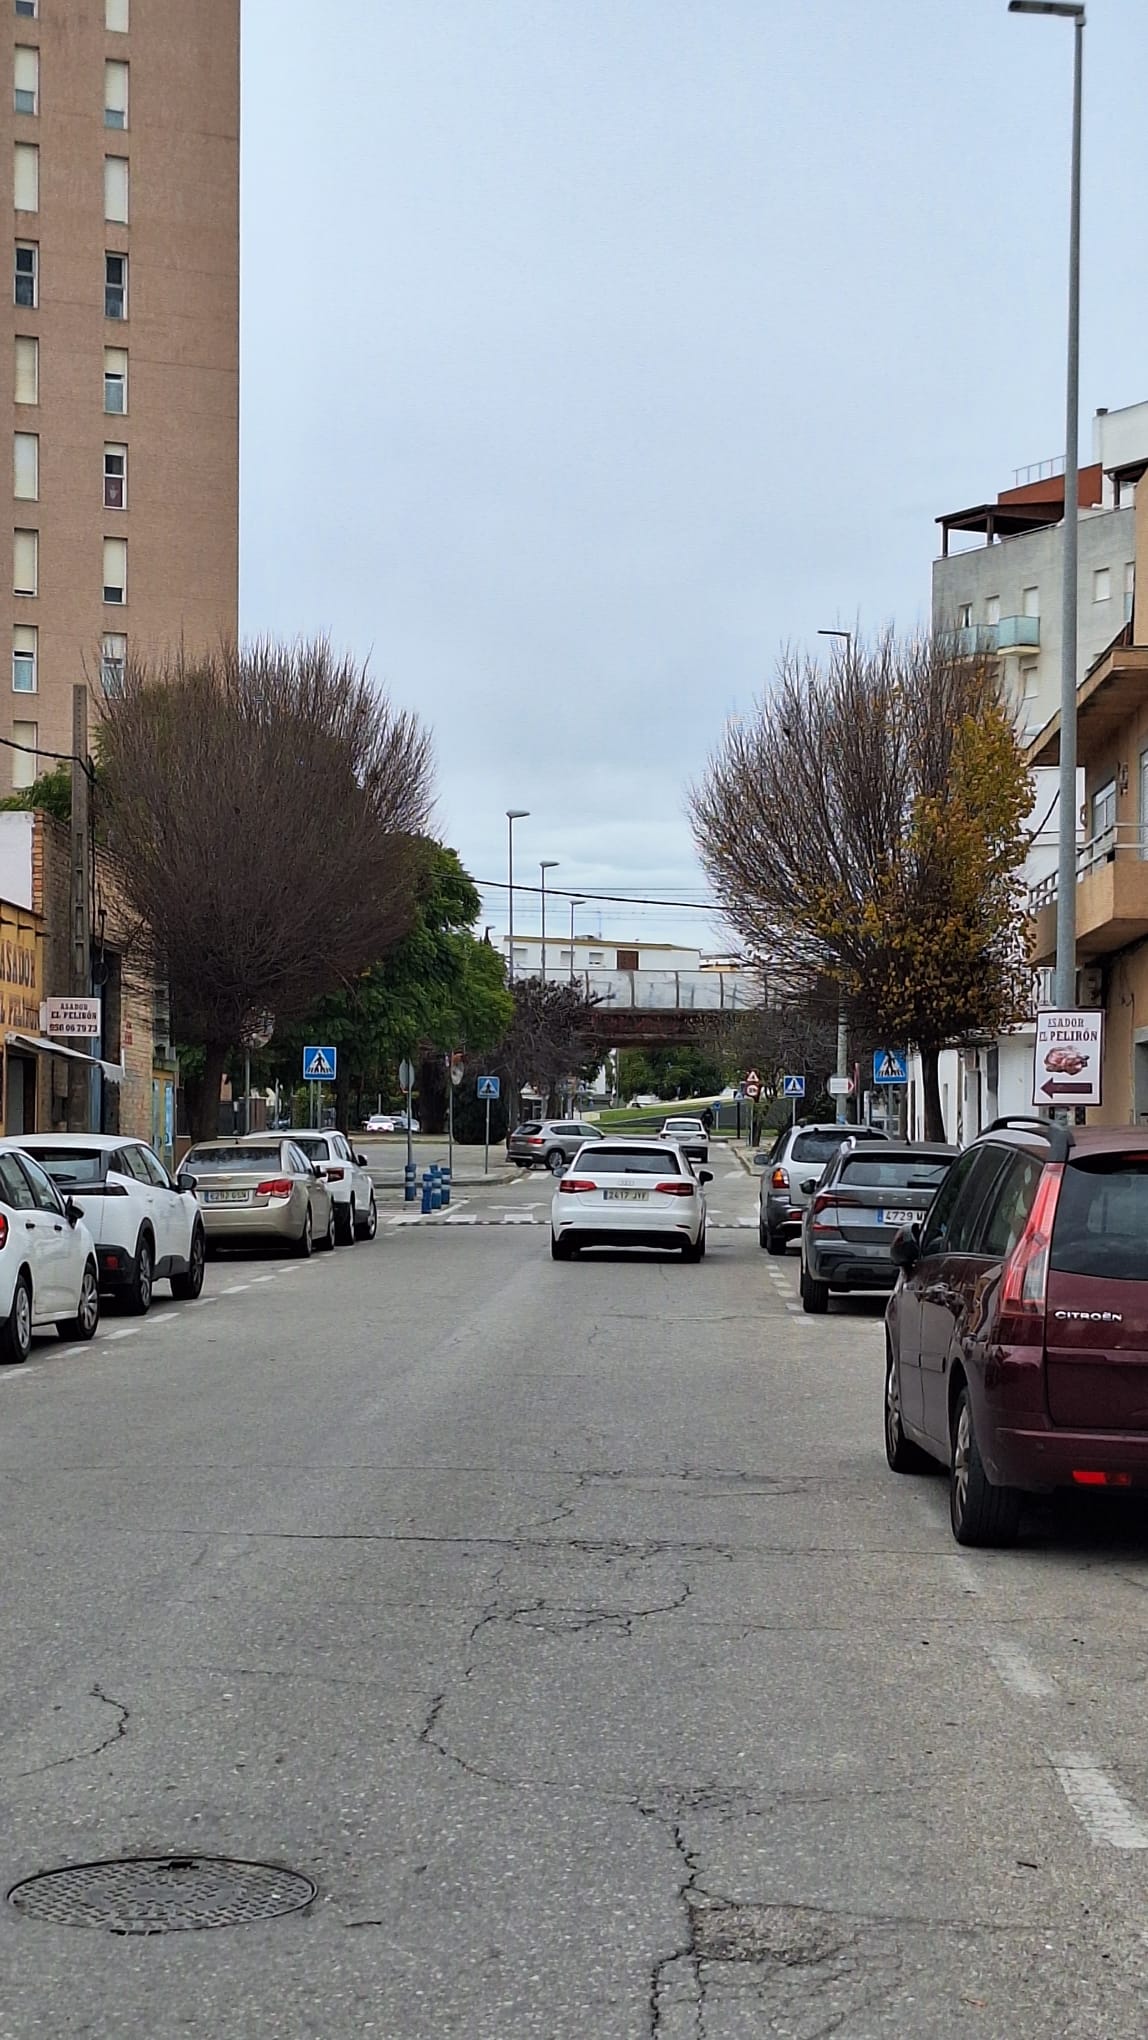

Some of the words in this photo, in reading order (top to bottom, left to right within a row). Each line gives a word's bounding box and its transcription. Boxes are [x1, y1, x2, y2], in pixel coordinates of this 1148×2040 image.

[51, 1011, 60, 1019] EL
[1048, 1018, 1084, 1027] ASADOR
[1039, 1031, 1048, 1041] EL
[1050, 1028, 1098, 1041] PELIRÓN
[885, 1210, 913, 1221] 4729
[1054, 1311, 1122, 1322] CITROËN
